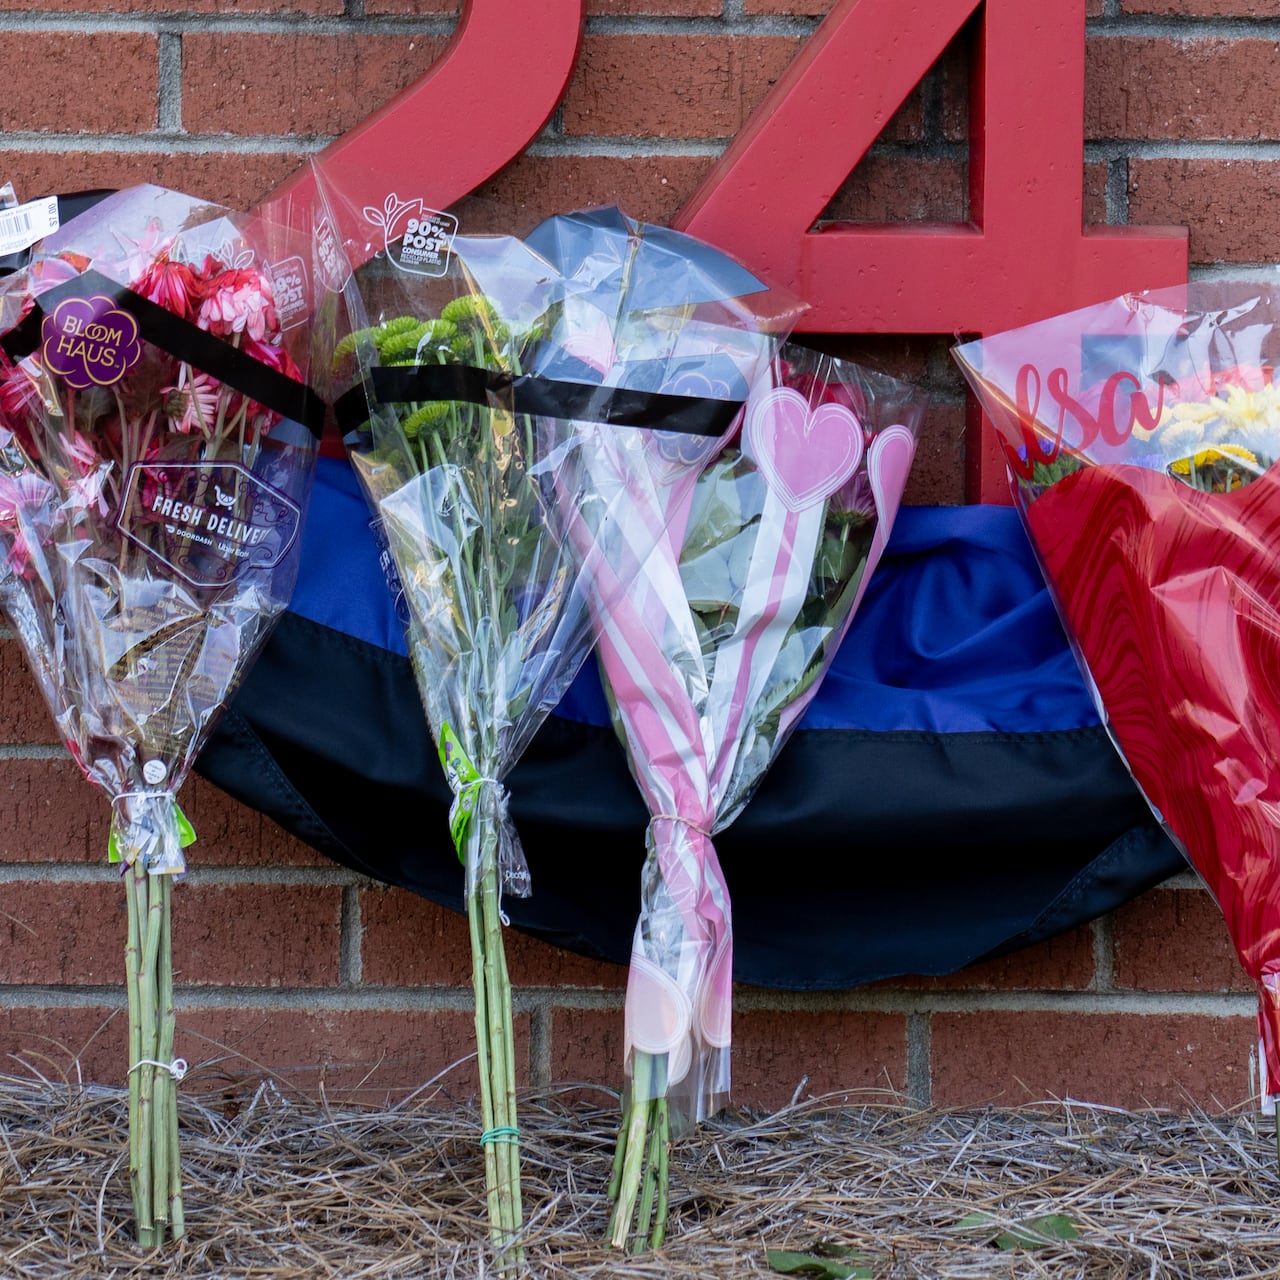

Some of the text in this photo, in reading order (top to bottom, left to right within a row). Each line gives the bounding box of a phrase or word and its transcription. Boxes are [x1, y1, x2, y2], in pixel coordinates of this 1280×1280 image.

[47, 202, 58, 228] $7.00
[407, 218, 447, 239] 90%
[402, 247, 439, 260] CONSUMER
[403, 233, 446, 253] POST
[61, 314, 123, 347] BLOOM
[56, 334, 117, 367] HAUS
[151, 495, 203, 527] FRESH
[176, 528, 213, 547] DOORDASH
